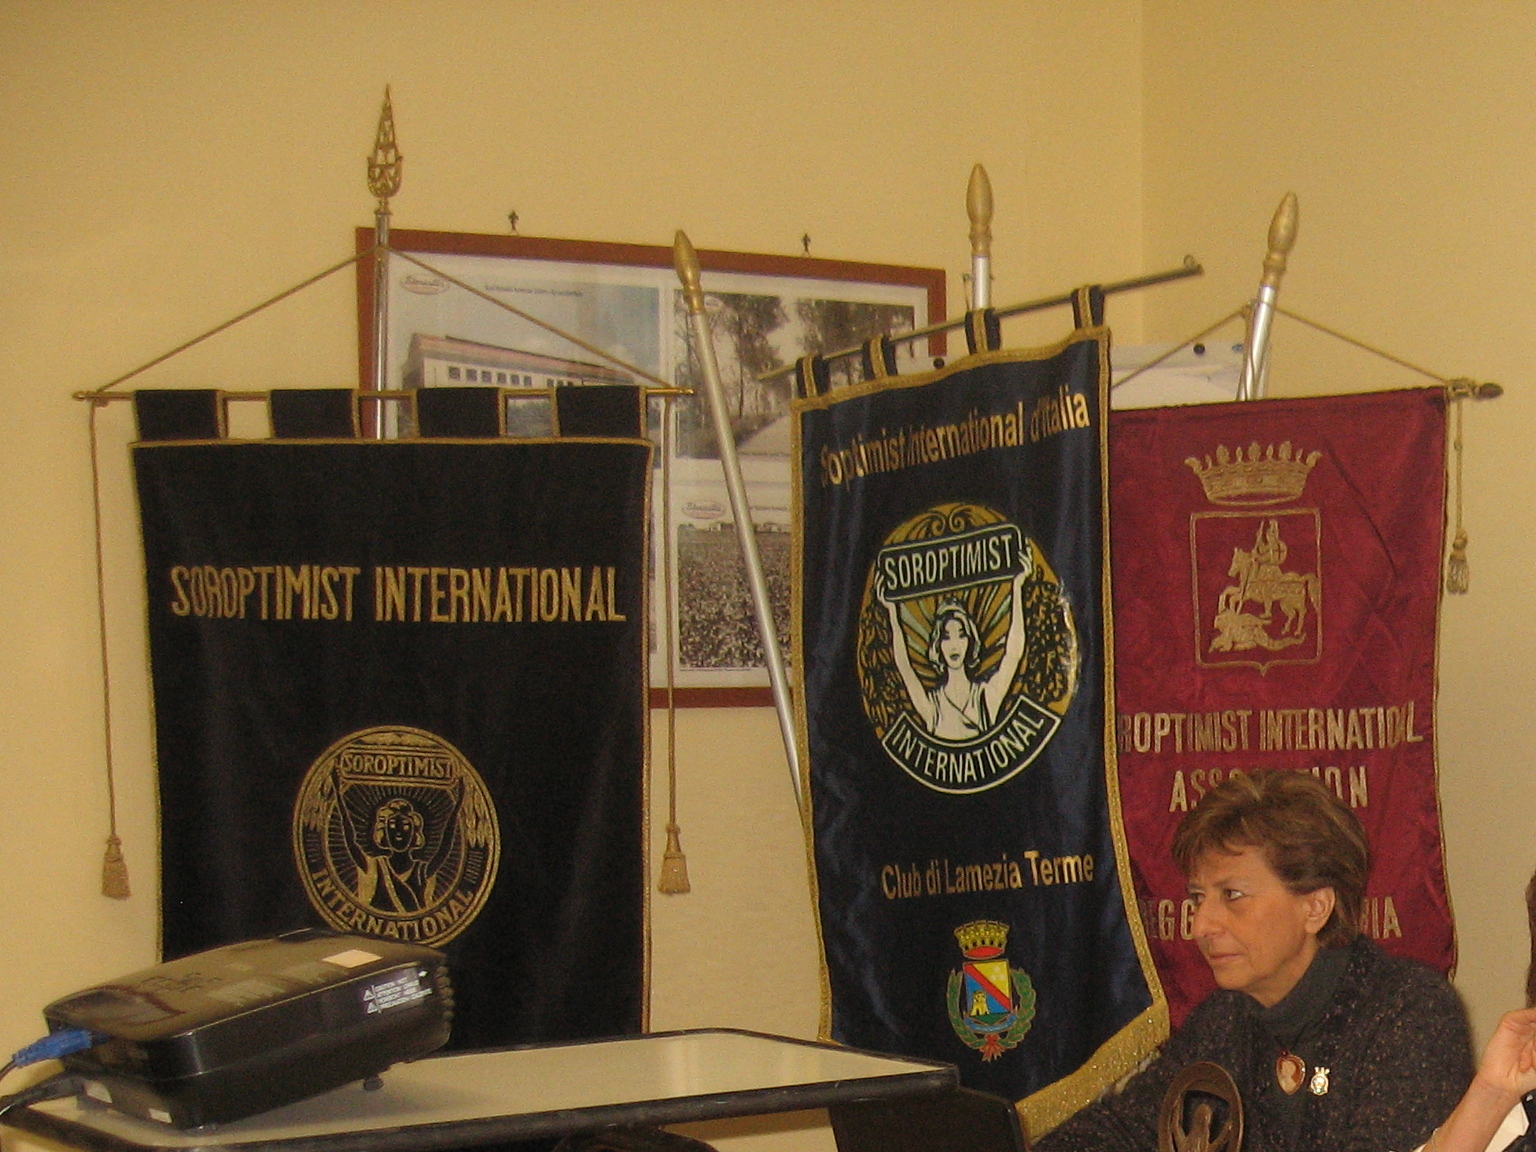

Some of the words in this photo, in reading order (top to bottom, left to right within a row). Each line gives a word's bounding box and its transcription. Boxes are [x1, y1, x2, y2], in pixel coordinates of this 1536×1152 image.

[885, 534, 1013, 591] SOROPTIMIST
[171, 565, 360, 620] SOROPTIMIST
[374, 566, 627, 623] INTERNATIONAL
[341, 754, 451, 778] SOROPTIMIST
[892, 711, 1045, 784] INTERNATIONAL
[881, 862, 922, 900] Club
[925, 858, 942, 896] di
[945, 853, 1023, 894] Lamezia
[1024, 850, 1095, 887] Terme
[312, 870, 475, 941] INTERNATIONAL
